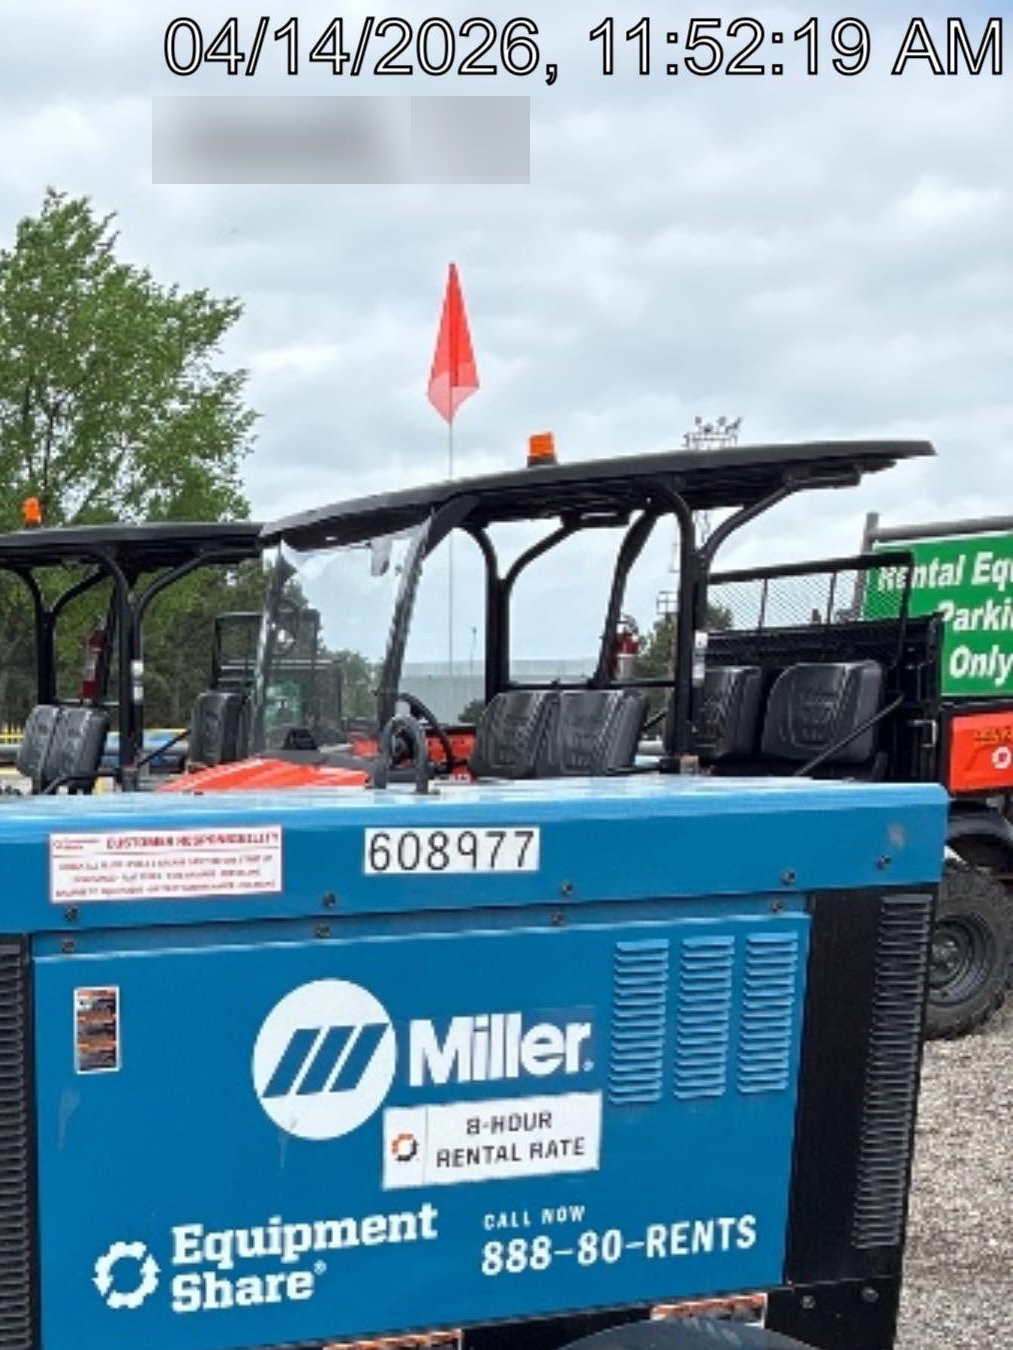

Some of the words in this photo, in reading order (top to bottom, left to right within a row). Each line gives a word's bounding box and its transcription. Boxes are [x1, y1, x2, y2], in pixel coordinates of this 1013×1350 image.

[971, 550, 1013, 592] Eq
[938, 596, 1013, 631] Parki
[949, 643, 1013, 687] Only
[369, 830, 534, 872] 608977
[466, 1111, 552, 1136] 8-HOUR
[436, 1143, 523, 1168] RENTAL
[529, 1136, 586, 1160] RATE
[171, 1202, 438, 1270] Equipment
[483, 1210, 531, 1231] CALL
[541, 1205, 586, 1225] NOW
[481, 1213, 757, 1276] 888-80-RENTS
